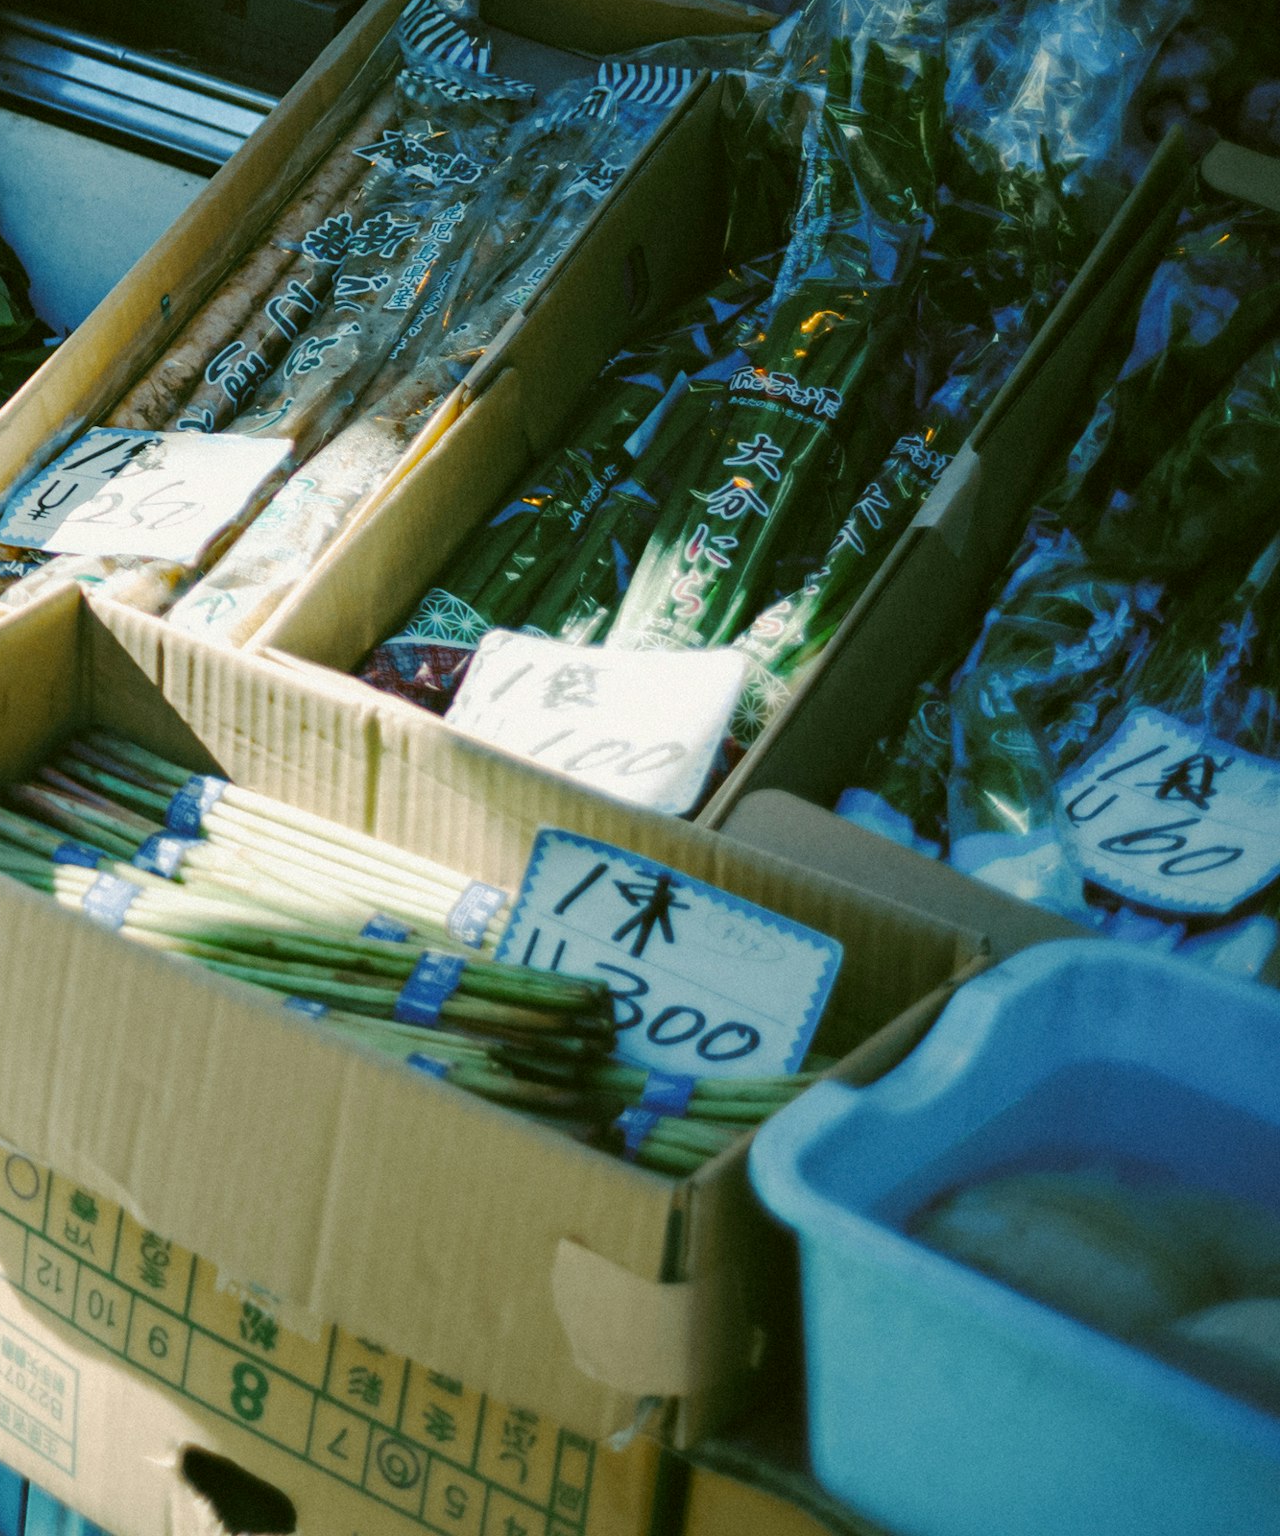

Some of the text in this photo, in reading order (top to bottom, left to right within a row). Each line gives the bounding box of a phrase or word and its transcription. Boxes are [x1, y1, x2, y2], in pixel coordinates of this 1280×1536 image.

[383, 201, 465, 312] 鹿児島県産
[671, 432, 785, 619] 大分にら
[63, 1218, 96, 1256] YR
[35, 1254, 66, 1296] 12
[87, 1289, 118, 1329] 10
[147, 1326, 169, 1359] 9
[228, 1361, 270, 1422] 8
[325, 1427, 350, 1460] 7
[385, 1454, 409, 1487] 6
[443, 1483, 468, 1519] 5
